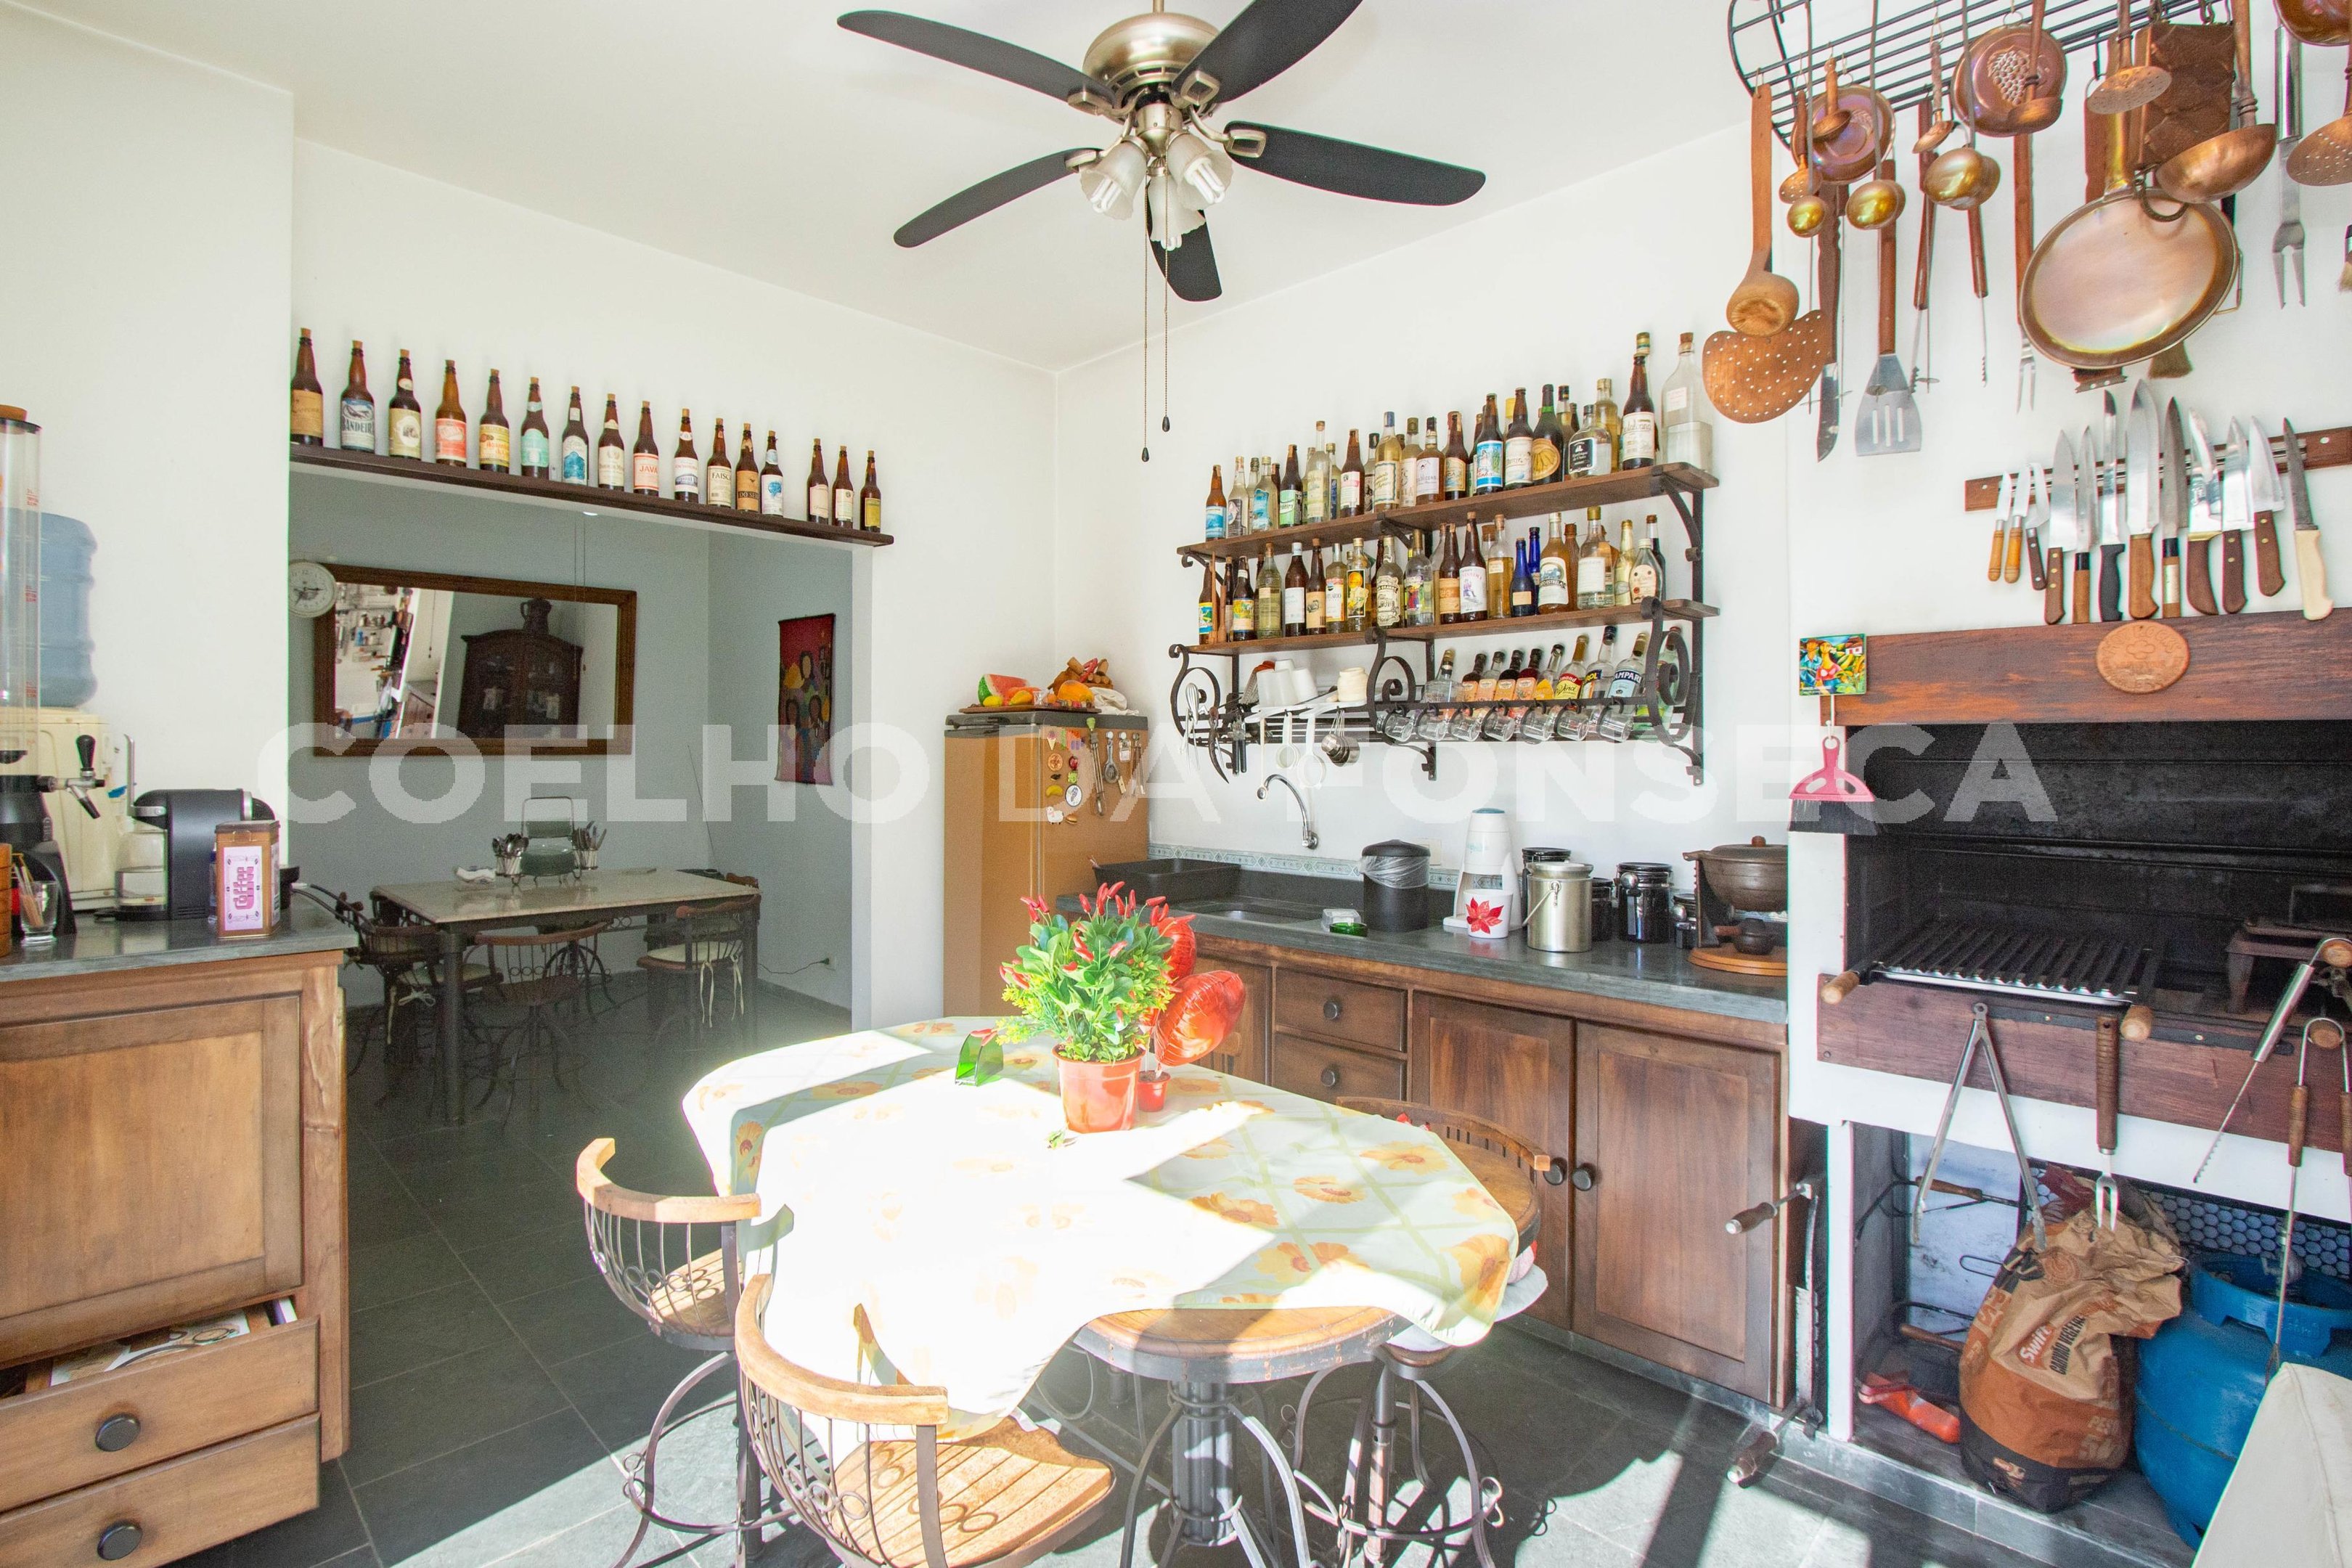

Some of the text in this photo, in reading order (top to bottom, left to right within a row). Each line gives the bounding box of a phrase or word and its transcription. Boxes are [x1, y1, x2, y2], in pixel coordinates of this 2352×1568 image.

[232, 866, 255, 910] Coffee
[2020, 1325, 2053, 1364] Swift
[2049, 1342, 2071, 1376] CARVÃO
